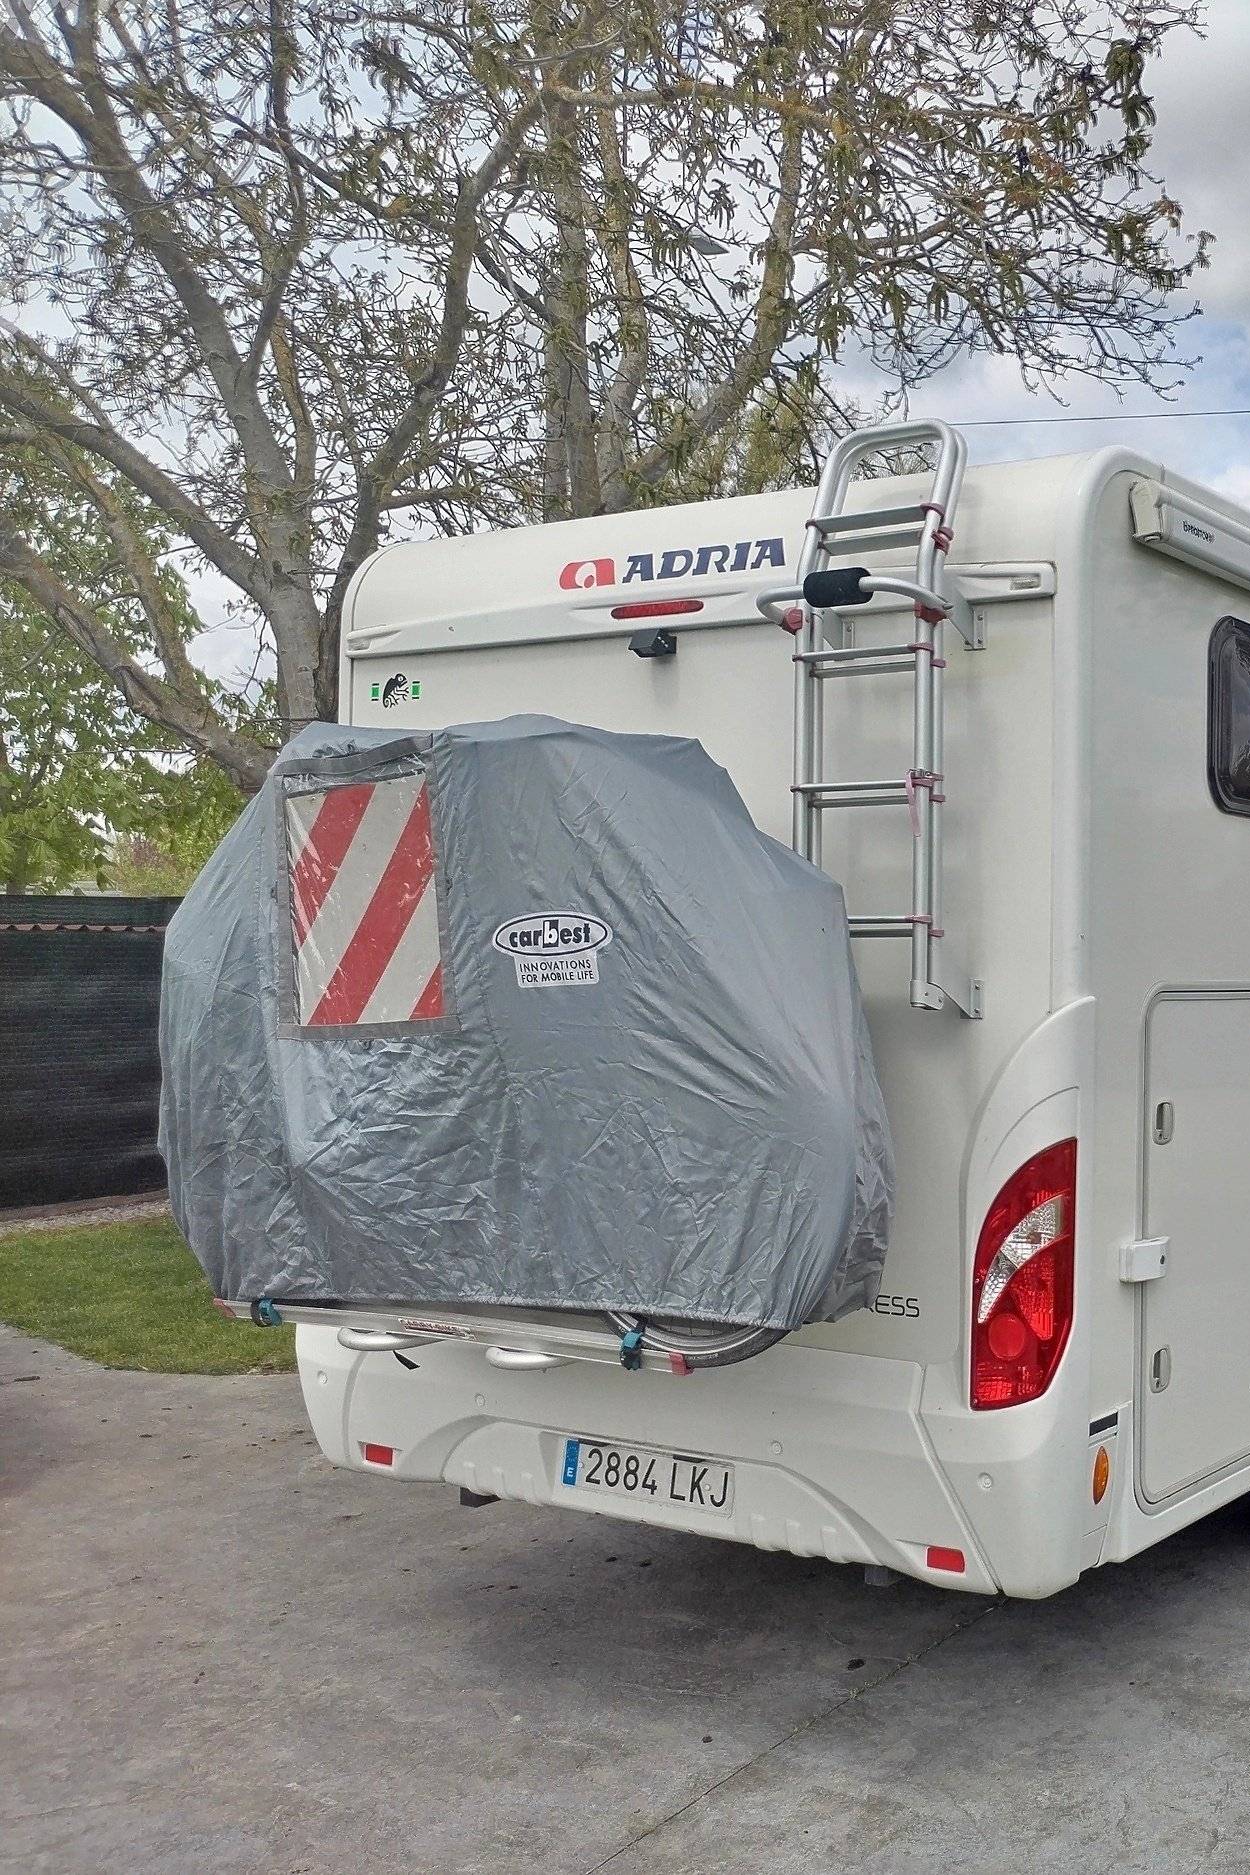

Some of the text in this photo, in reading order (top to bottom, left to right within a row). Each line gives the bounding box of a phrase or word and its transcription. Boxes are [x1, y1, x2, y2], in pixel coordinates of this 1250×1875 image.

[622, 538, 786, 584] ADRIA
[508, 919, 591, 948] carbest
[519, 959, 592, 973] INNOVATIONS
[522, 970, 594, 984] FOR MOBILE LIFE
[566, 1448, 729, 1508] E 2884 LKJ
